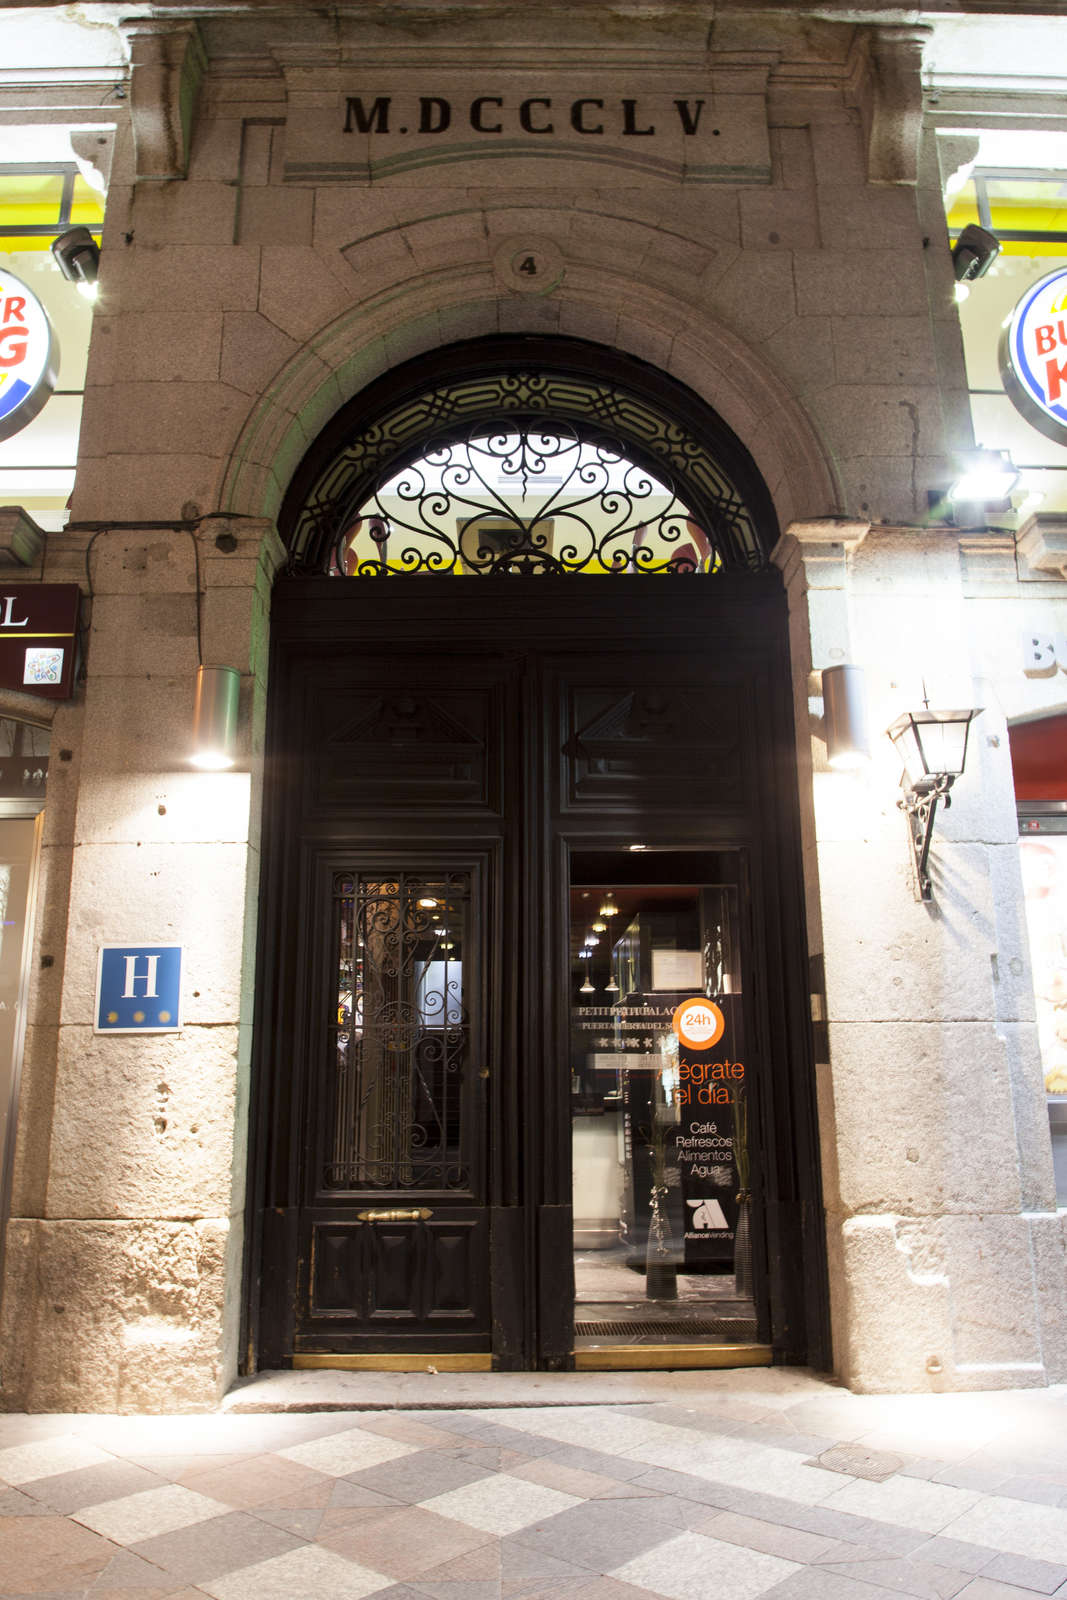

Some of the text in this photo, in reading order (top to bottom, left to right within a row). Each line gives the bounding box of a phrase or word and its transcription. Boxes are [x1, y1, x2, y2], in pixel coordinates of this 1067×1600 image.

[519, 256, 537, 275] 4
[0, 296, 26, 323] R
[0, 597, 29, 626] L
[121, 955, 161, 998] H
[685, 1014, 711, 1025] 24h
[656, 1058, 745, 1085] égrate
[674, 1084, 691, 1105] el
[690, 1121, 717, 1134] Café
[676, 1136, 733, 1148] Refrescos
[677, 1149, 732, 1162] Alimentos
[690, 1163, 721, 1177] Agua
